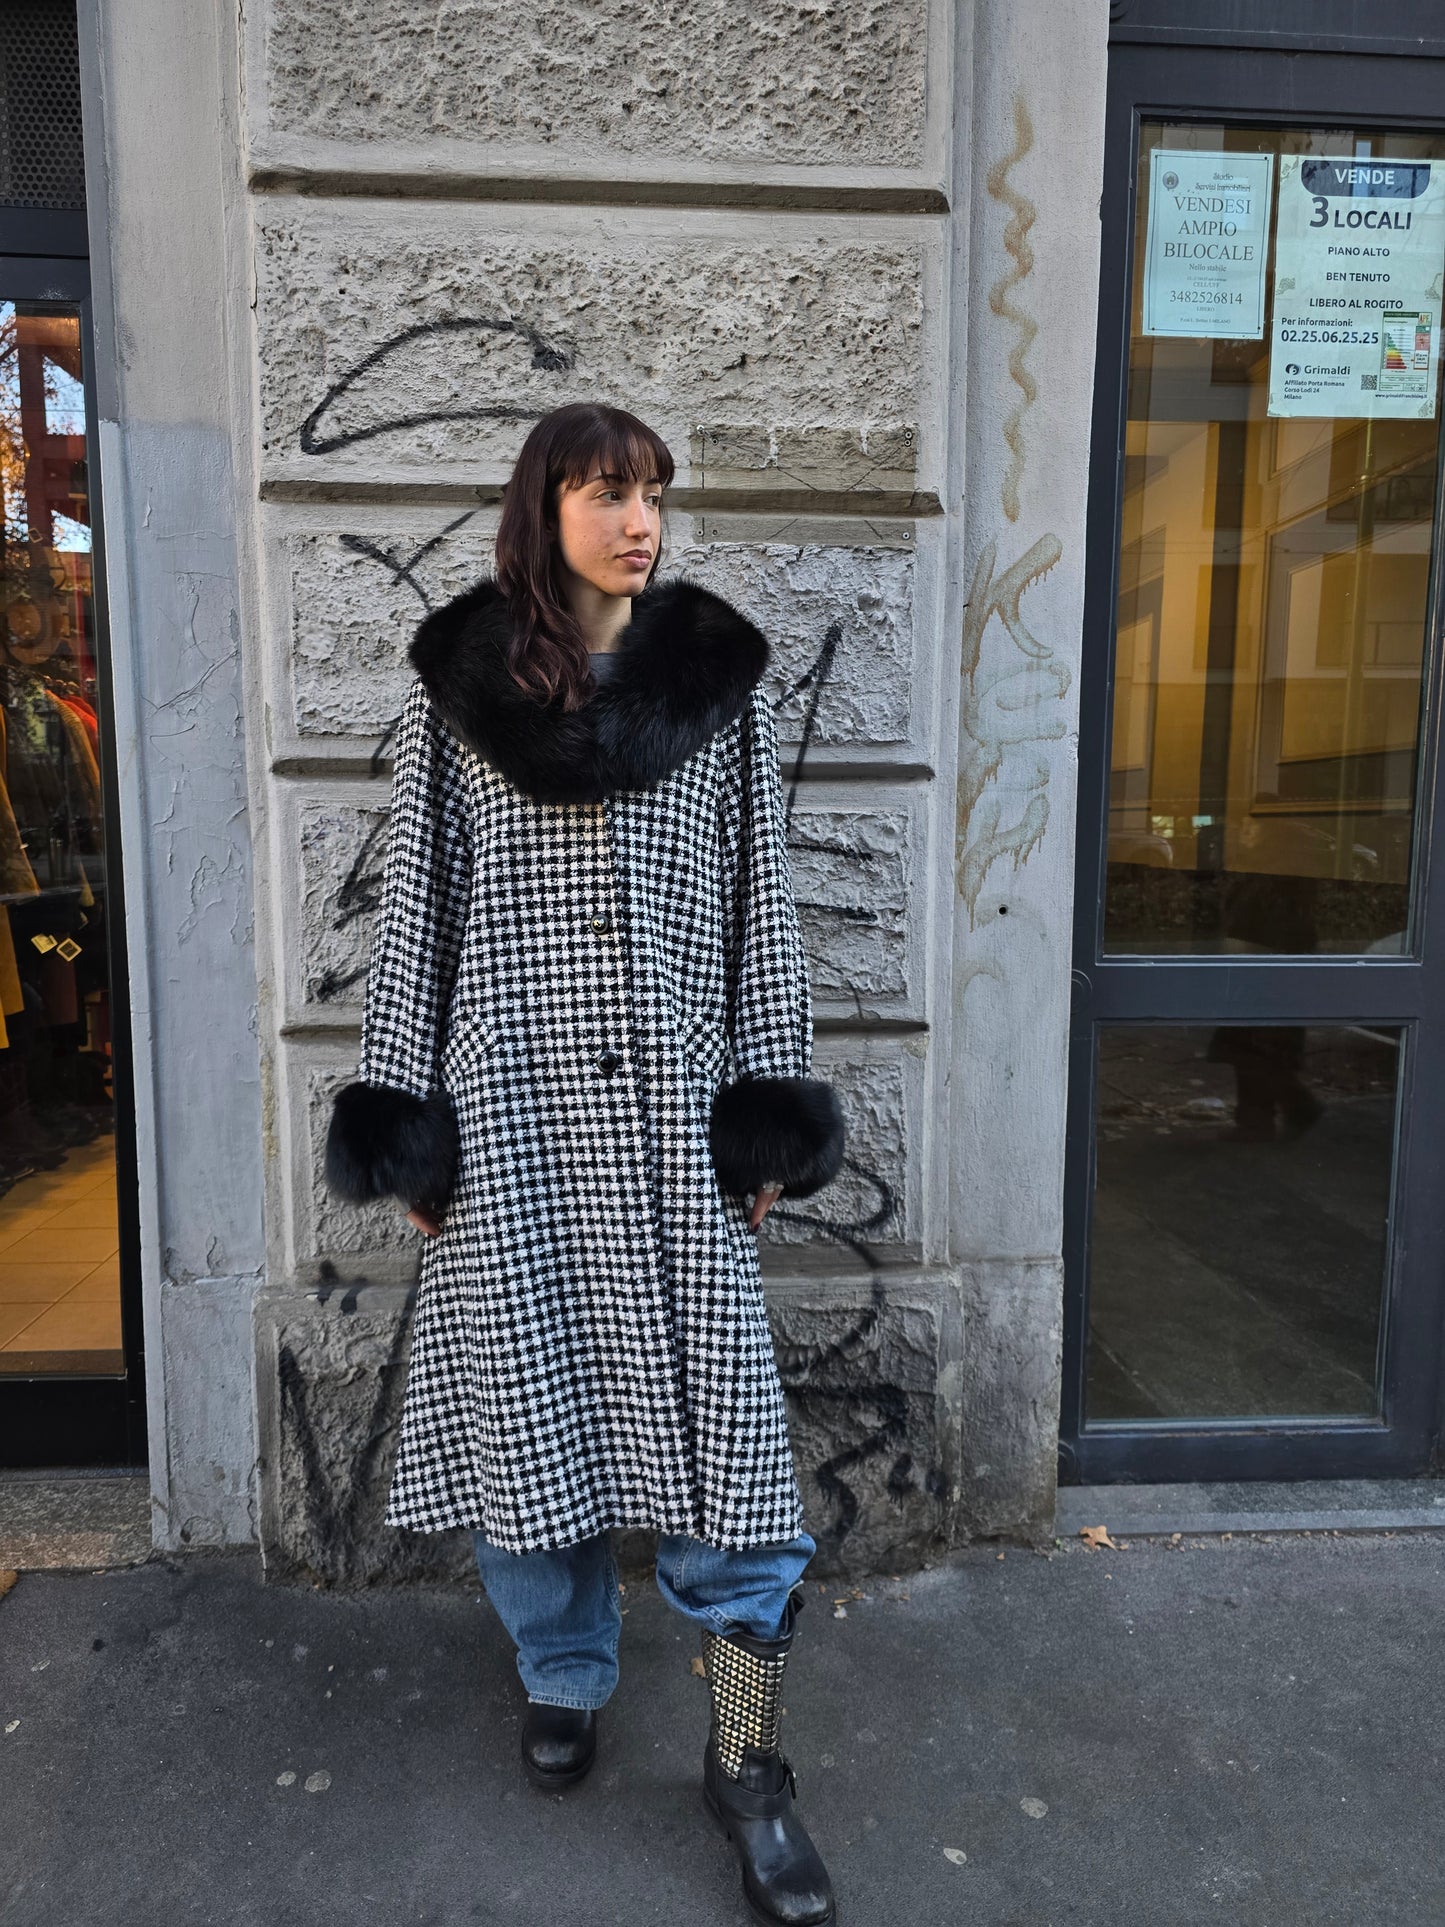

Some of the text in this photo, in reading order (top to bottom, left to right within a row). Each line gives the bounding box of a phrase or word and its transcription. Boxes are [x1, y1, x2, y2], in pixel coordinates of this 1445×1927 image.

[1335, 169, 1395, 185] VENDE
[1174, 196, 1251, 214] VENDESI
[1309, 196, 1412, 230] 3 LOCALI
[1178, 220, 1237, 236] AMPIO
[1164, 243, 1254, 261] BILOCALE
[1328, 247, 1390, 257] PIANO ALTO
[1326, 272, 1390, 282] BEN TENUTO
[1170, 291, 1243, 305] 3482526814
[1309, 298, 1403, 309] LIBERO AL ROGITO
[1281, 318, 1353, 327] Per informazioni:
[1281, 330, 1379, 344] 02.25.06.25.25
[1304, 365, 1350, 375] Grimaldi
